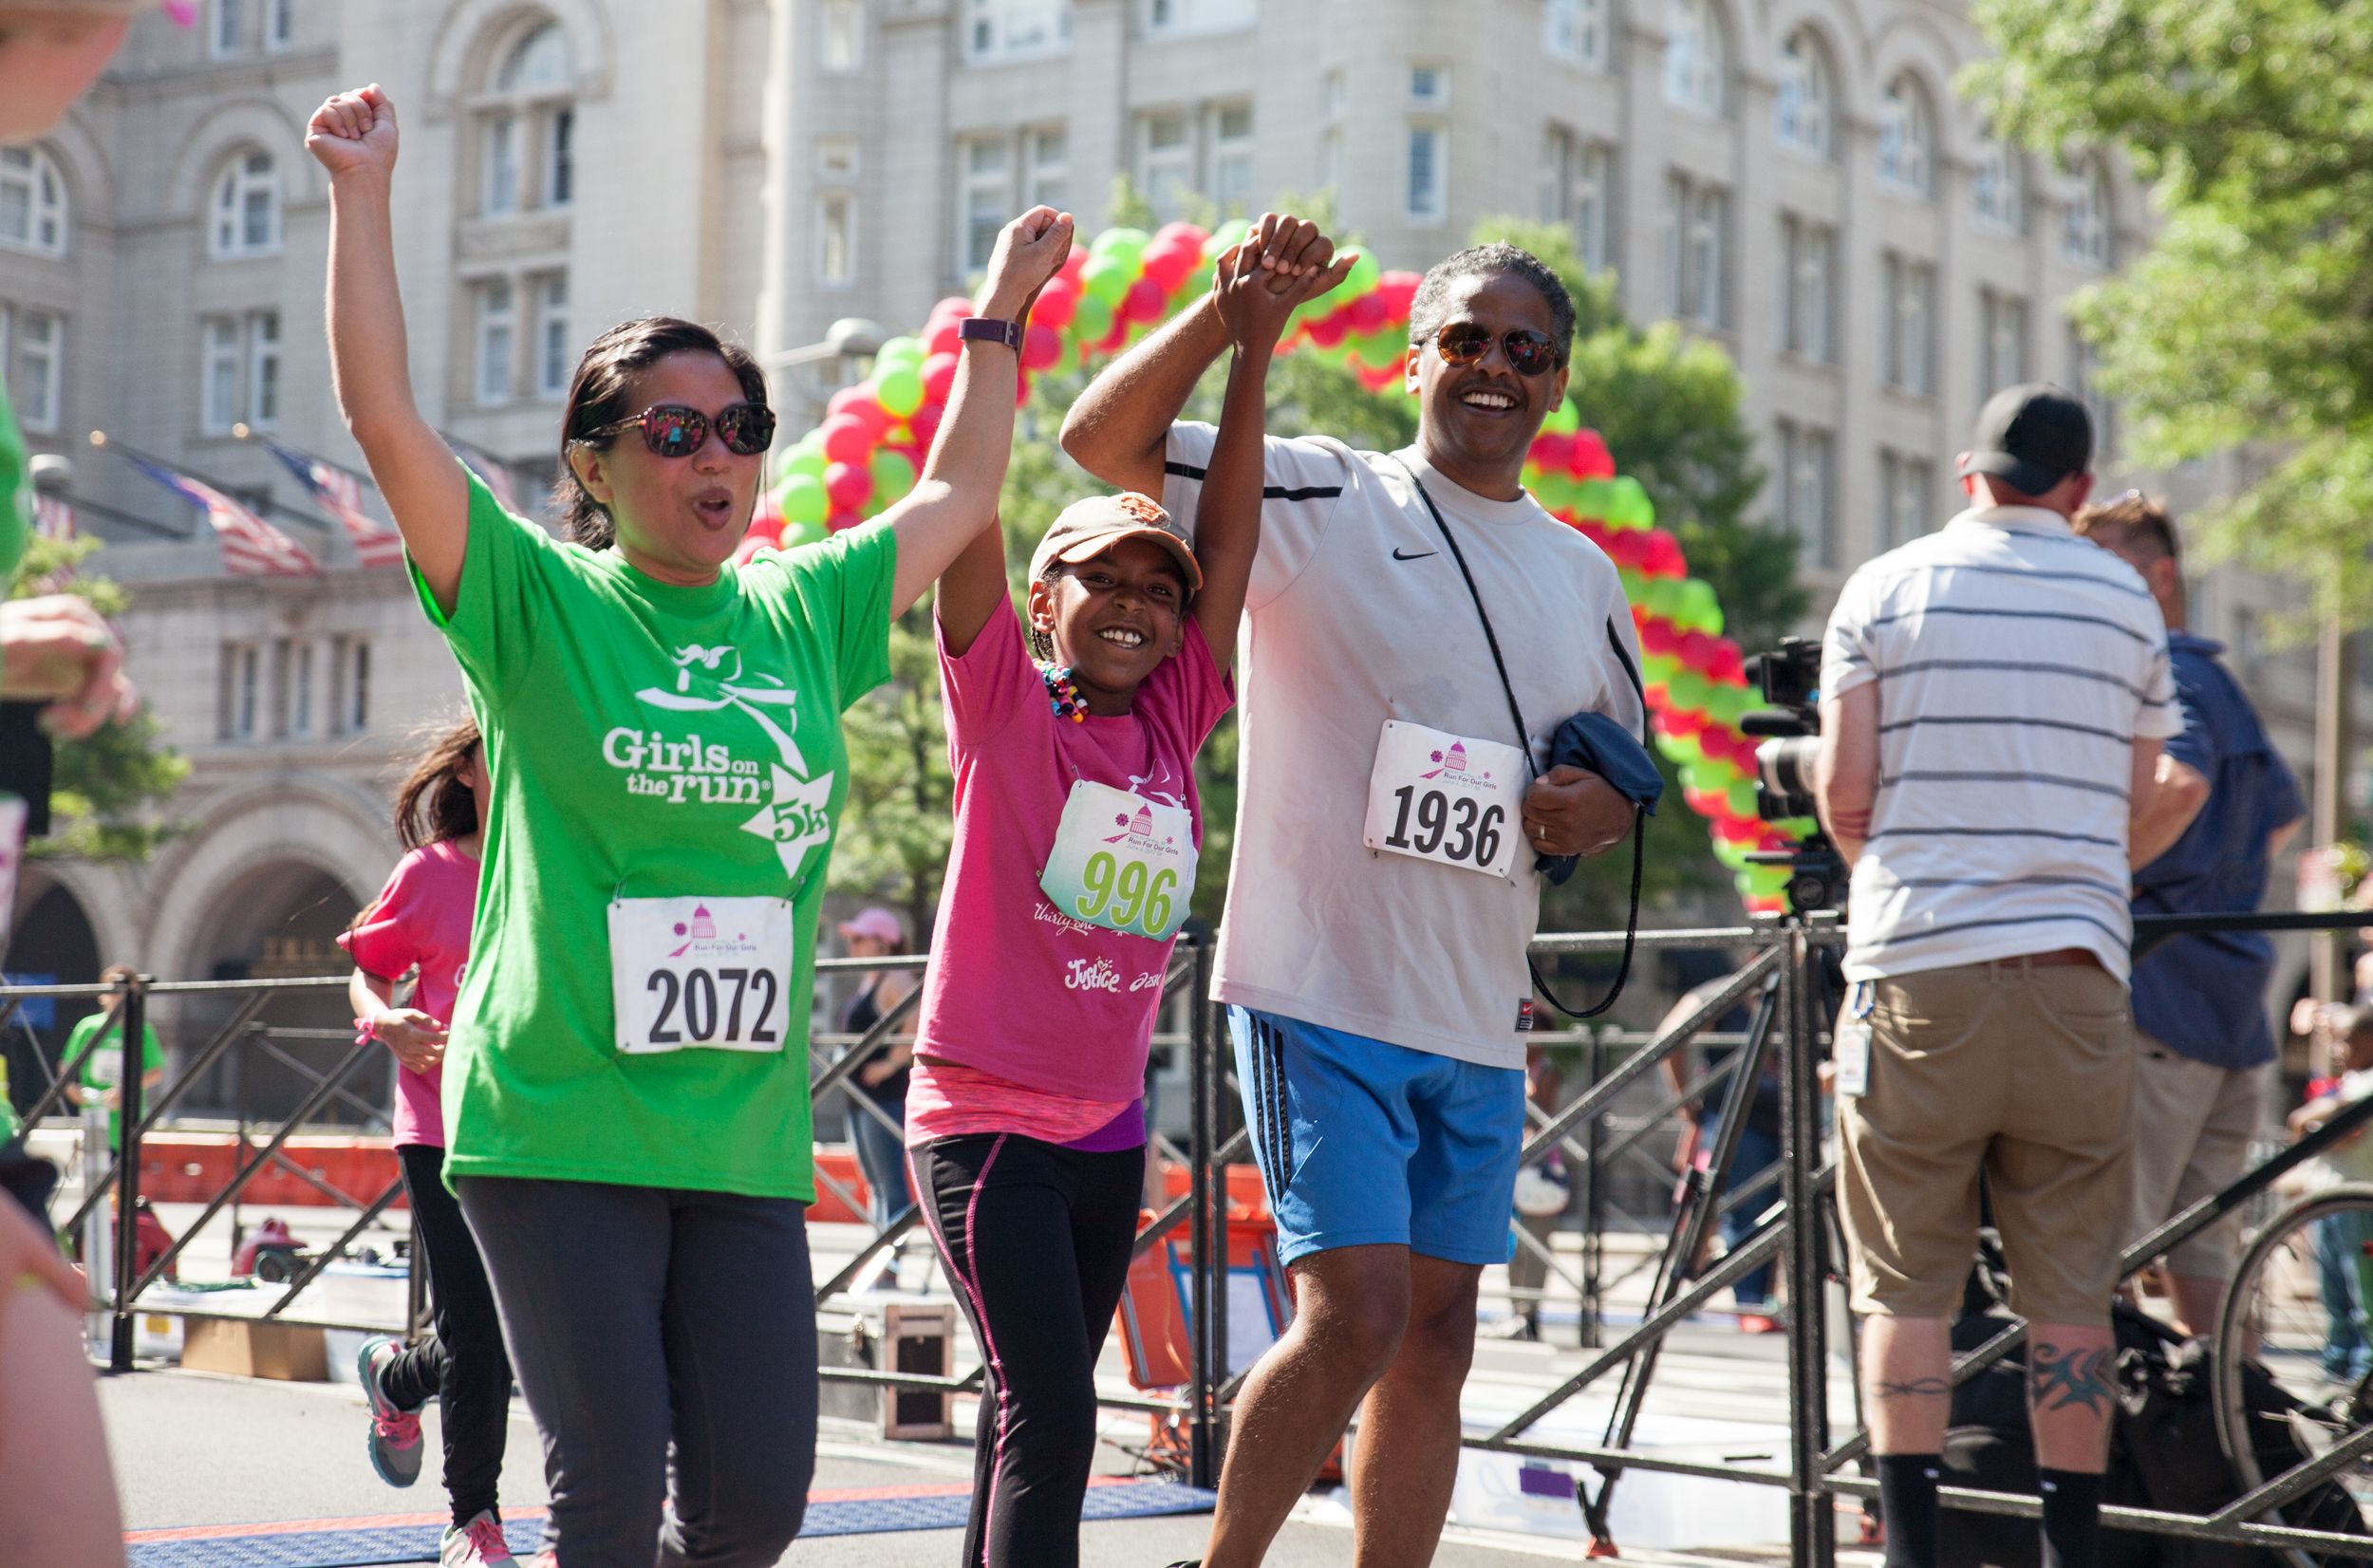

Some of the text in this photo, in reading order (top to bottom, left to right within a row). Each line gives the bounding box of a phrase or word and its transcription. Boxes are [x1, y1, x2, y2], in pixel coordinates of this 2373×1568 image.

[602, 727, 760, 775] Girls on
[626, 774, 668, 796] the
[1444, 772, 1457, 780] Run
[1458, 775, 1469, 783] For
[1483, 781, 1497, 790] Girls
[1385, 785, 1505, 868] 1936
[1128, 836, 1142, 846] Run
[1142, 840, 1153, 849] For
[1153, 843, 1165, 852] Our
[1165, 847, 1179, 855] Girls
[1076, 850, 1178, 936] 996
[1033, 903, 1097, 937] thirty-one
[1064, 957, 1121, 993] Justice
[646, 967, 778, 1044] 2072
